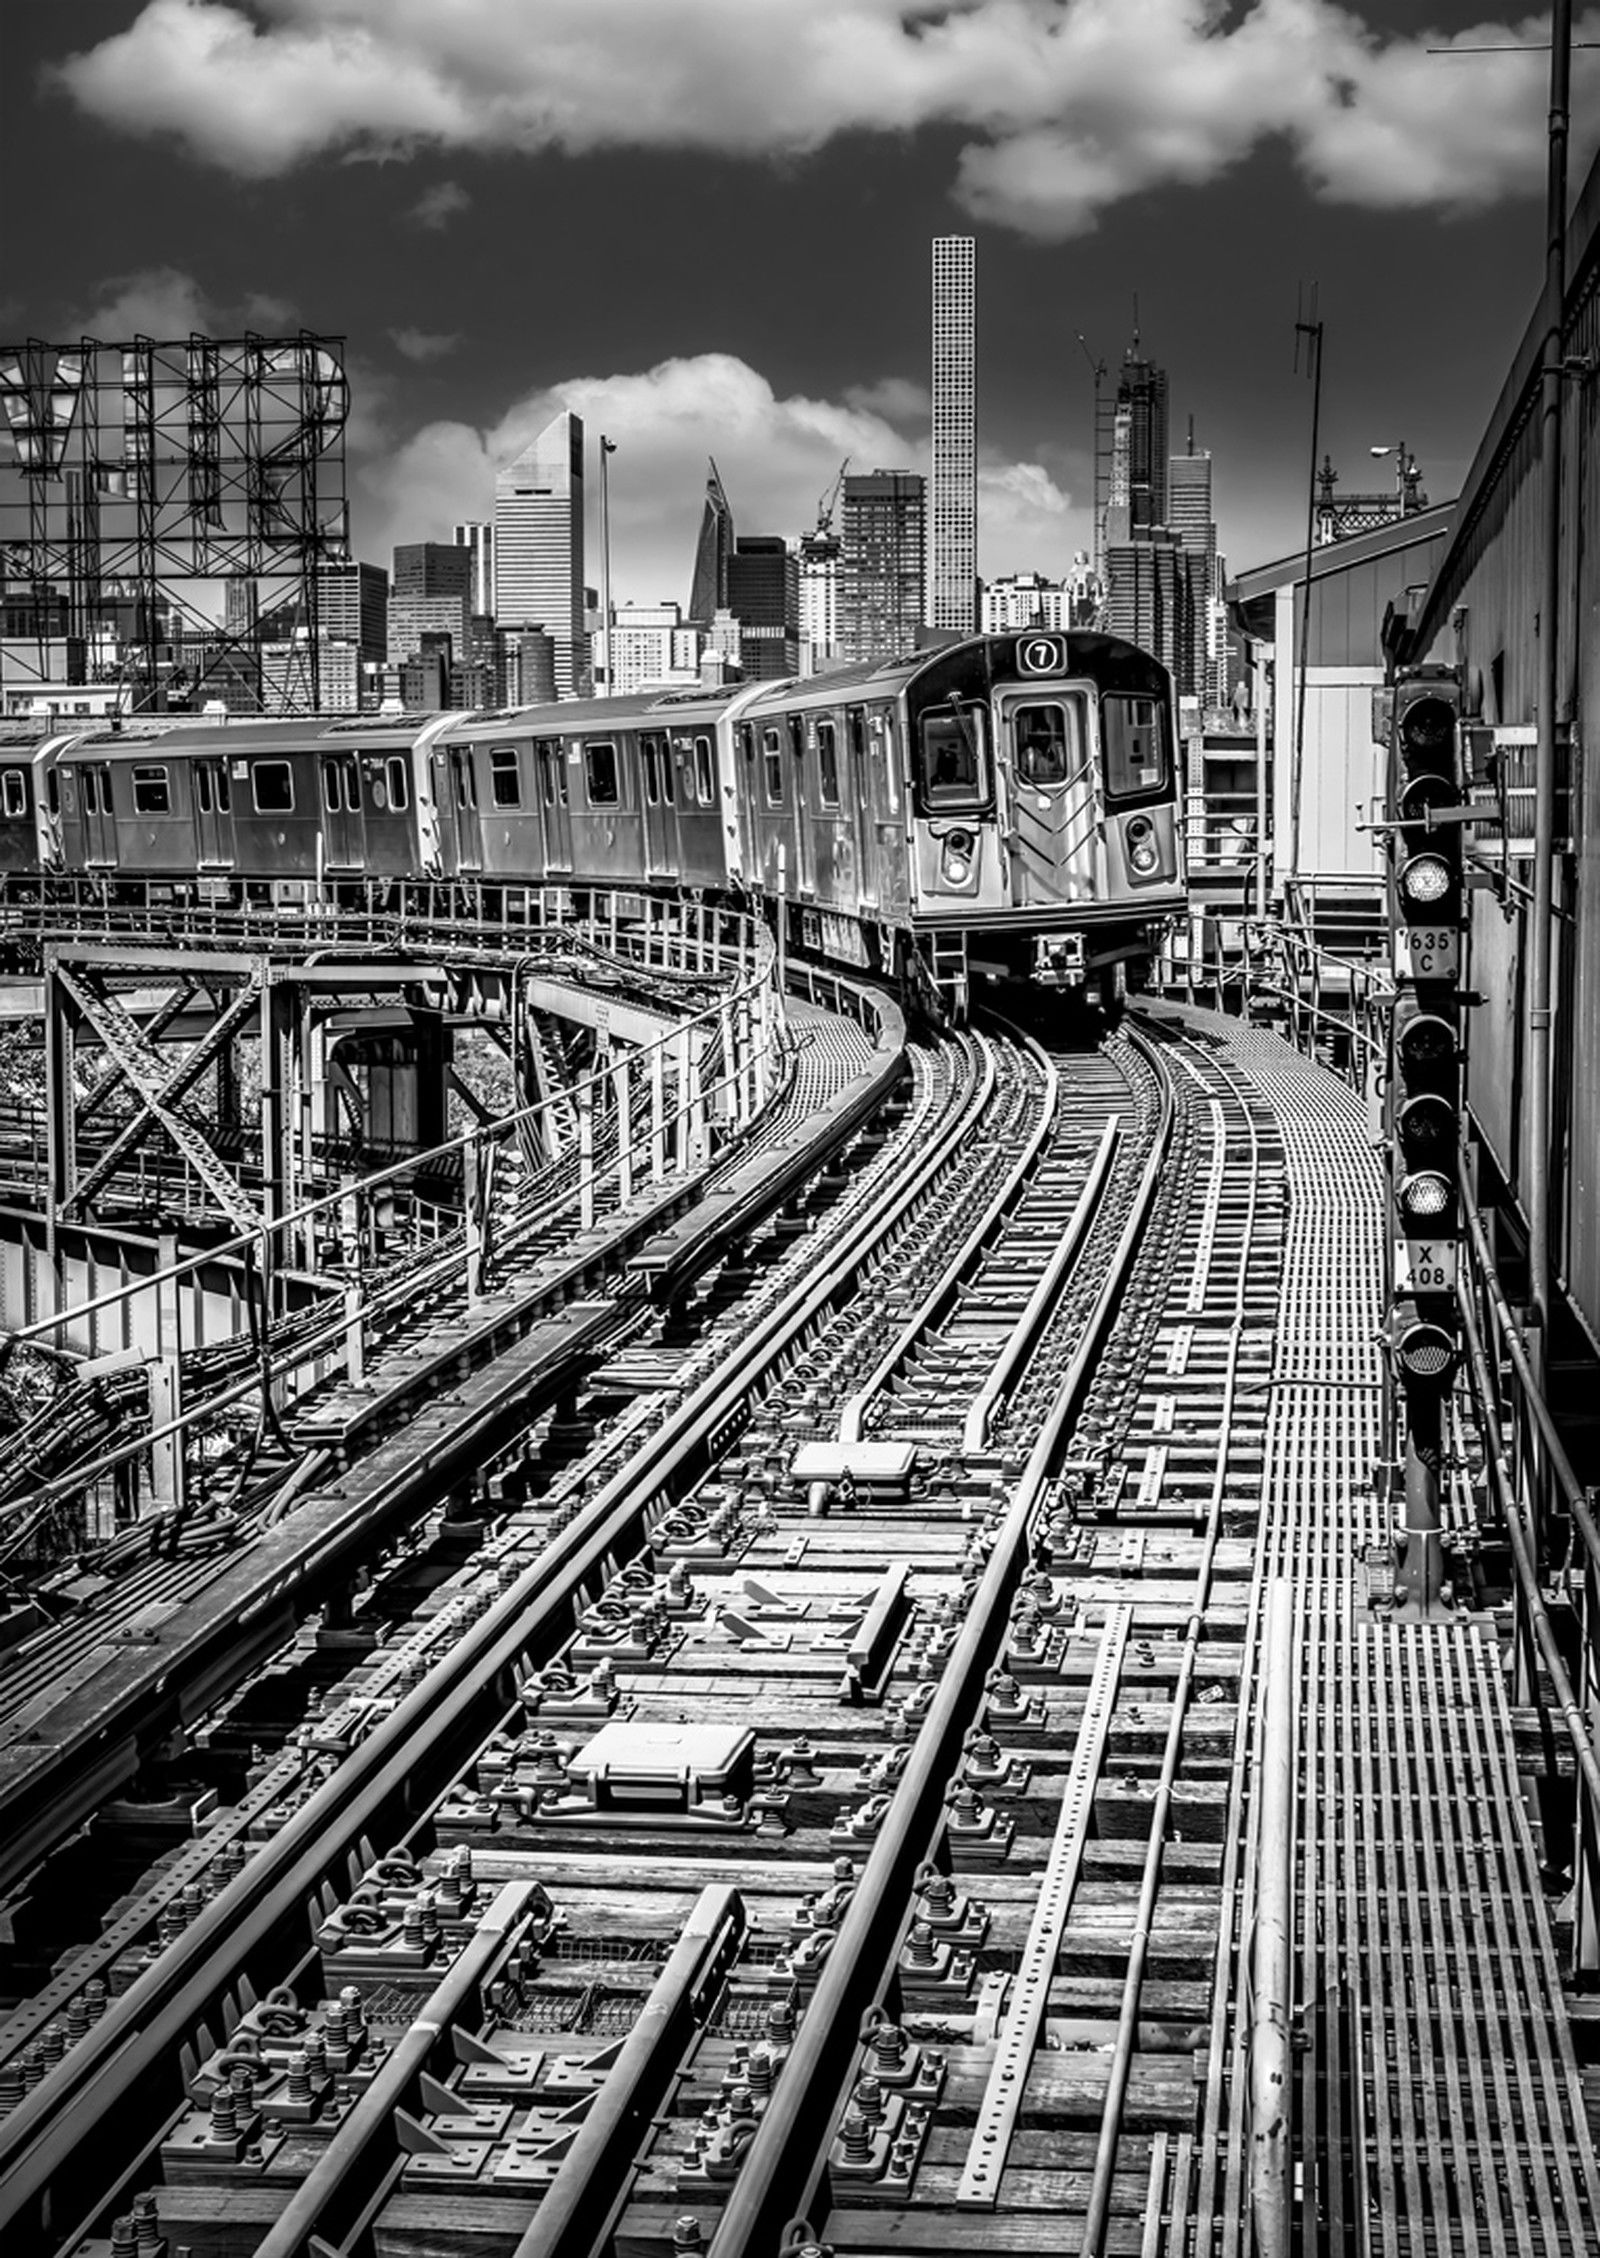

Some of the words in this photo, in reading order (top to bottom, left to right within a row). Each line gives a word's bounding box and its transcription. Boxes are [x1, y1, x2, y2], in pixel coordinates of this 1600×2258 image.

[1034, 645, 1047, 666] 7
[1420, 954, 1433, 972] C
[1419, 1246, 1433, 1264] X
[1406, 1268, 1445, 1285] 408
